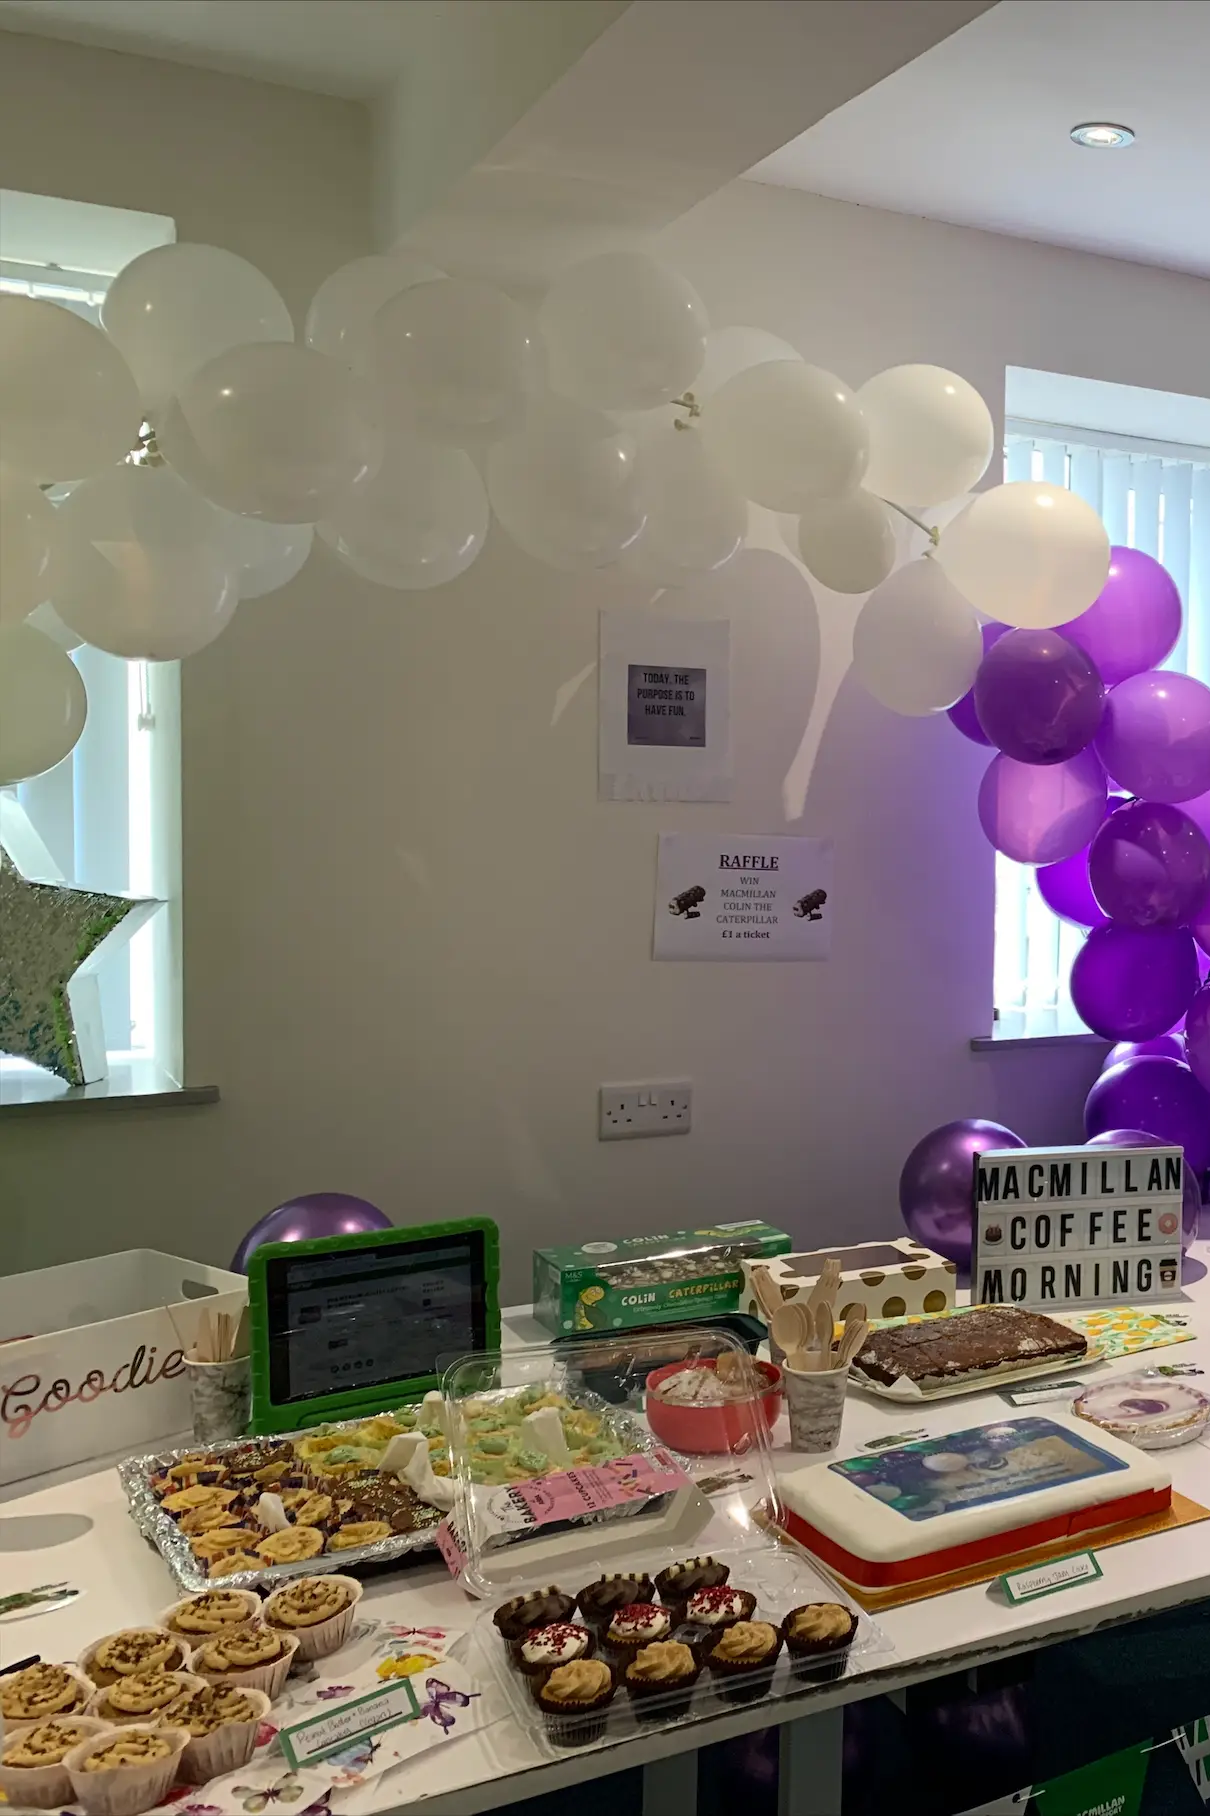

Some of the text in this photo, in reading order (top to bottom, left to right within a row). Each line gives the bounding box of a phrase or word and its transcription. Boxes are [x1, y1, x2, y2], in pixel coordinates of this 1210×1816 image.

[674, 674, 690, 686] THE
[637, 688, 695, 701] PURPOSE IS TO
[645, 704, 687, 717] HAVE FUN.
[719, 854, 779, 870] RAFFLE
[740, 876, 760, 885] WIN
[720, 889, 776, 898] MACMILLAN
[723, 902, 773, 911] COLIN THE
[716, 915, 779, 924] CATERPILLAR
[722, 929, 770, 939] £1 a ticket
[978, 1157, 1181, 1201] MACMILLAN
[1010, 1208, 1152, 1250] COFFEE
[564, 1271, 583, 1279] M&S
[981, 1258, 1152, 1304] MORNING
[504, 1486, 537, 1524] BAKERY
